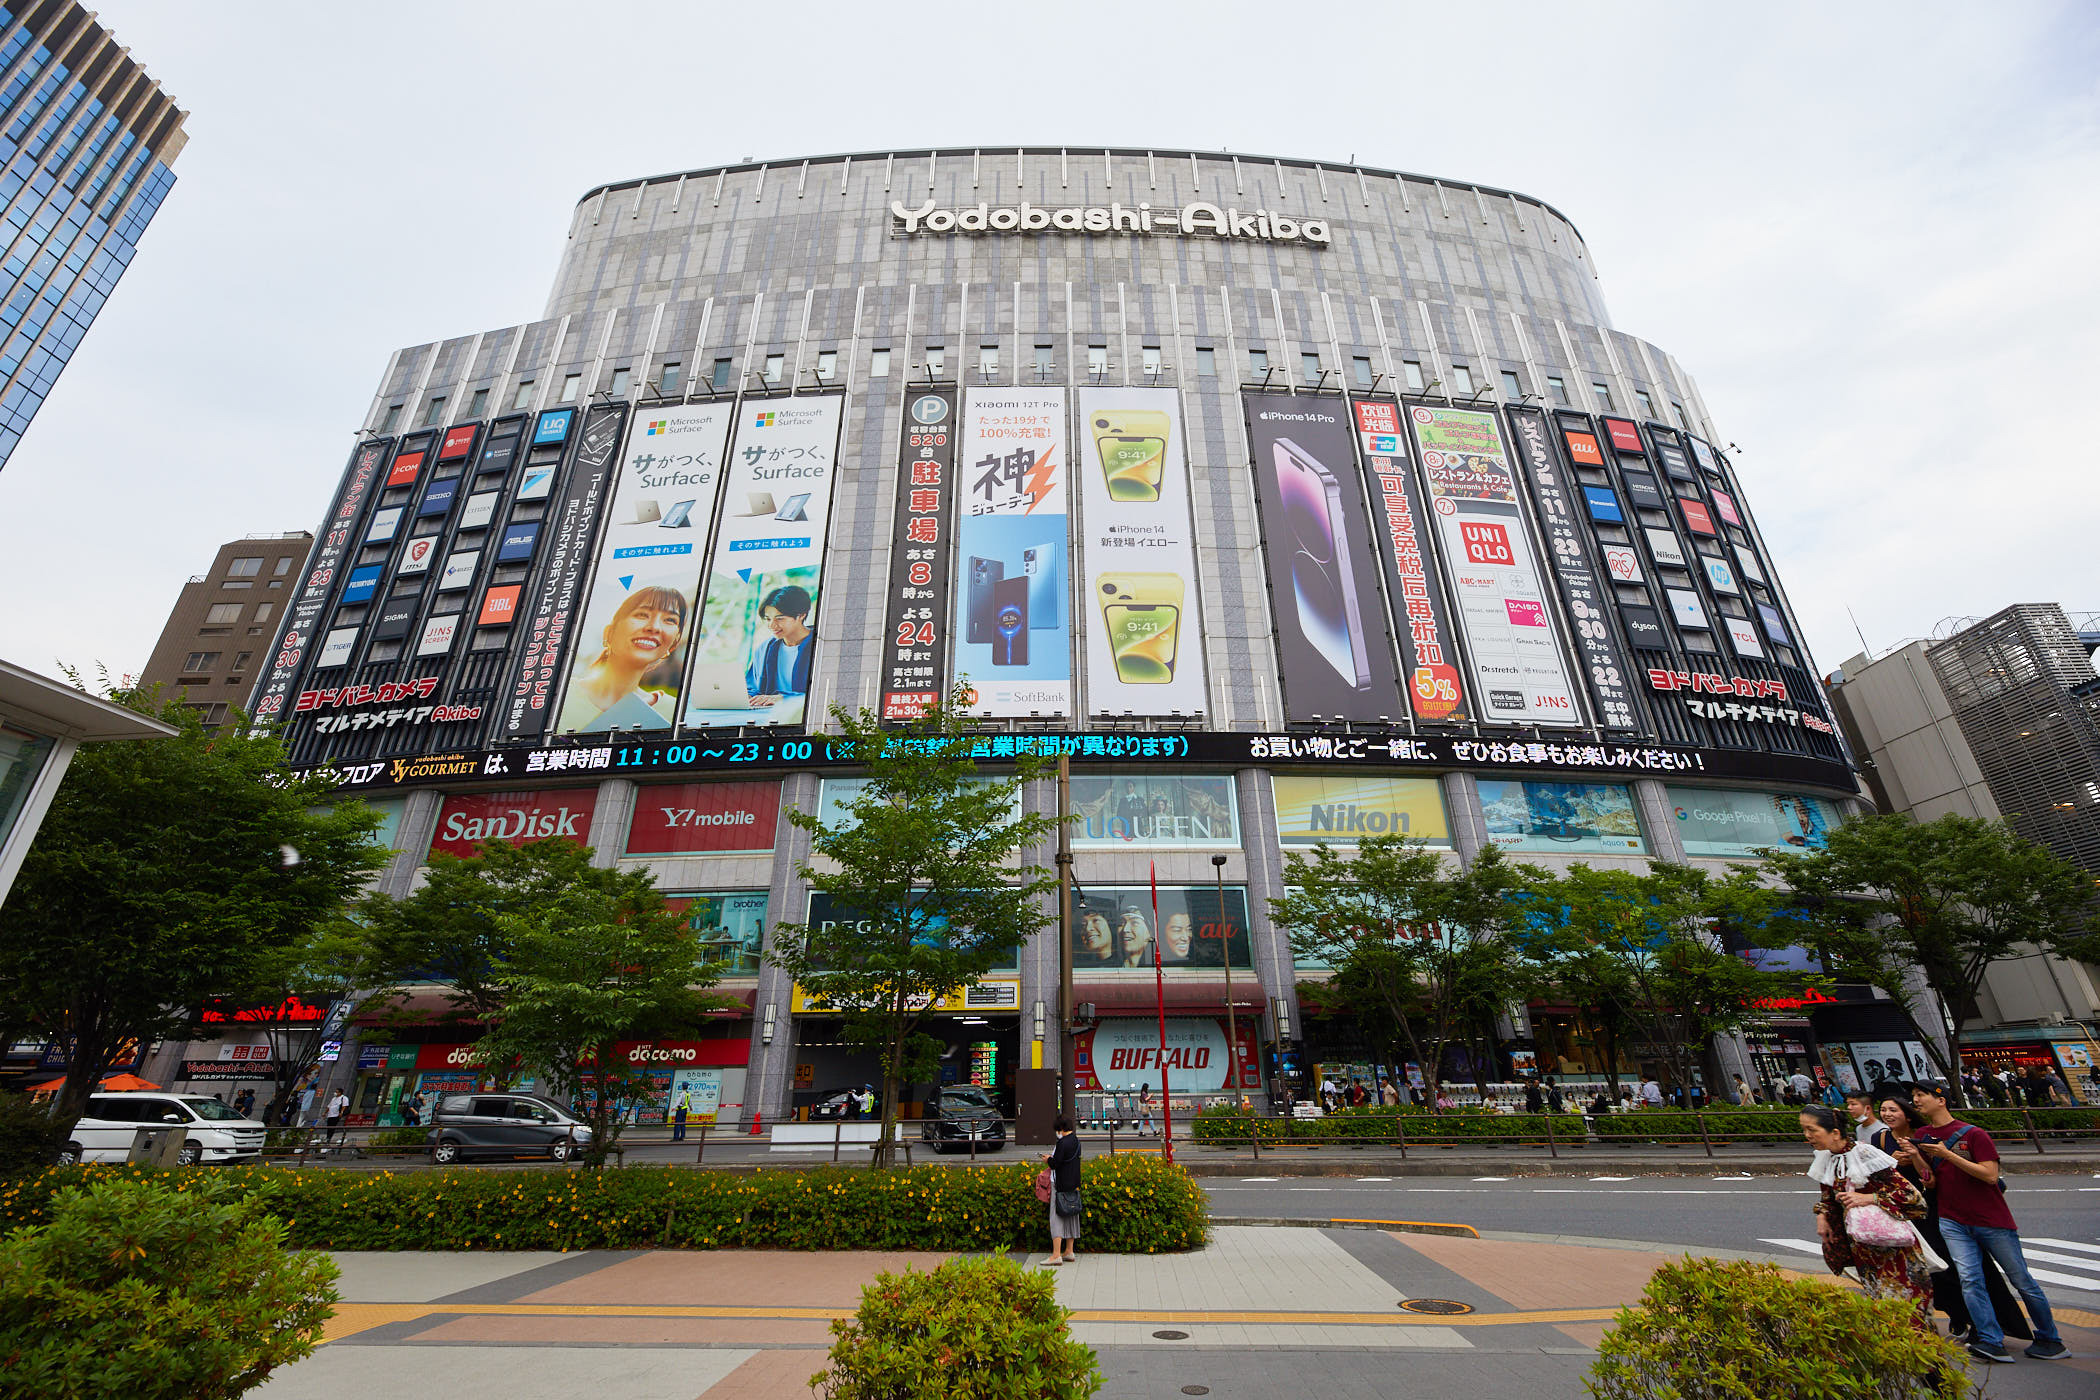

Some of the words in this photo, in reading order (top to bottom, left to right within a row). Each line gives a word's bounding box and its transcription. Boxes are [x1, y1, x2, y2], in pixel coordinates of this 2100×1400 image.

[891, 199, 1331, 243] Yodobashi-Akiba
[779, 409, 823, 418] Microsoft
[921, 399, 941, 420] P
[670, 417, 713, 426] Microsoft
[777, 417, 813, 426] Surface
[1268, 411, 1304, 421] iPhone
[1304, 413, 1317, 422] 14
[1318, 414, 1335, 423] Pro
[544, 418, 565, 430] UQ
[668, 425, 703, 434] Surface
[910, 434, 946, 446] 520
[920, 447, 934, 458] 台
[1572, 443, 1596, 453] au
[1118, 451, 1146, 459] 9:41
[752, 464, 825, 481] Surface
[640, 471, 711, 489] Surface
[1440, 482, 1482, 491] Restaurants
[1540, 488, 1559, 497] あさ
[427, 491, 452, 500] SEIKO
[907, 461, 941, 543] 駐車場
[1542, 498, 1566, 515] 11
[1117, 525, 1152, 533] iPhone
[1154, 525, 1164, 533] 14
[1465, 526, 1502, 543] UNI
[1553, 528, 1573, 536] よる
[327, 530, 347, 547] 11
[505, 535, 534, 545] ASUS
[737, 539, 803, 549] そのサに触れよう
[1100, 537, 1178, 547] 新登場イエロー
[620, 546, 686, 556] そのサに触れよう
[1471, 543, 1508, 561] QLO
[1553, 537, 1581, 556] 23
[906, 549, 936, 560] あさ
[1656, 550, 1681, 560] Nikon
[318, 559, 335, 568] よる
[308, 569, 333, 587] 23
[909, 562, 931, 585] 8
[903, 587, 934, 599] 時から
[1508, 602, 1539, 611] DAISO
[383, 613, 408, 622] SIGMA
[902, 607, 933, 619] よる
[1127, 622, 1158, 632] 9:41
[1578, 619, 1606, 640] 30
[1631, 621, 1658, 632] dyson
[896, 621, 936, 646] 24
[1733, 632, 1756, 643] TCL
[424, 635, 449, 645] SCREEN
[275, 650, 301, 669] 30
[530, 610, 568, 709] どこで使っても
[898, 649, 931, 661] 時まで
[893, 667, 933, 677] 高さ制限
[1592, 665, 1622, 687] 22
[1415, 667, 1457, 700] 5%
[1648, 668, 1786, 701] ヨドバシカメラ
[295, 676, 439, 712] ヨドバシカメラ
[1014, 691, 1065, 703] SoftBank
[257, 694, 284, 714] 22
[315, 706, 433, 734] マルチメディア
[431, 704, 481, 722] Akiba
[508, 698, 526, 730] 貯まる
[1686, 699, 1799, 727] マルチメディア
[1250, 736, 1438, 761] お買い物とご一緒に、
[409, 762, 477, 777] GOURMET
[484, 753, 509, 774] は、
[525, 747, 612, 773] 営業時間
[1310, 804, 1410, 833] Nikon
[1693, 809, 1734, 825] Google
[1735, 811, 1761, 824] Pixel
[442, 807, 581, 842] SanDisk
[734, 900, 765, 909] brother
[1200, 922, 1239, 939] au
[629, 1045, 697, 1061] docomo
[1110, 1047, 1210, 1070] BUFFALO
